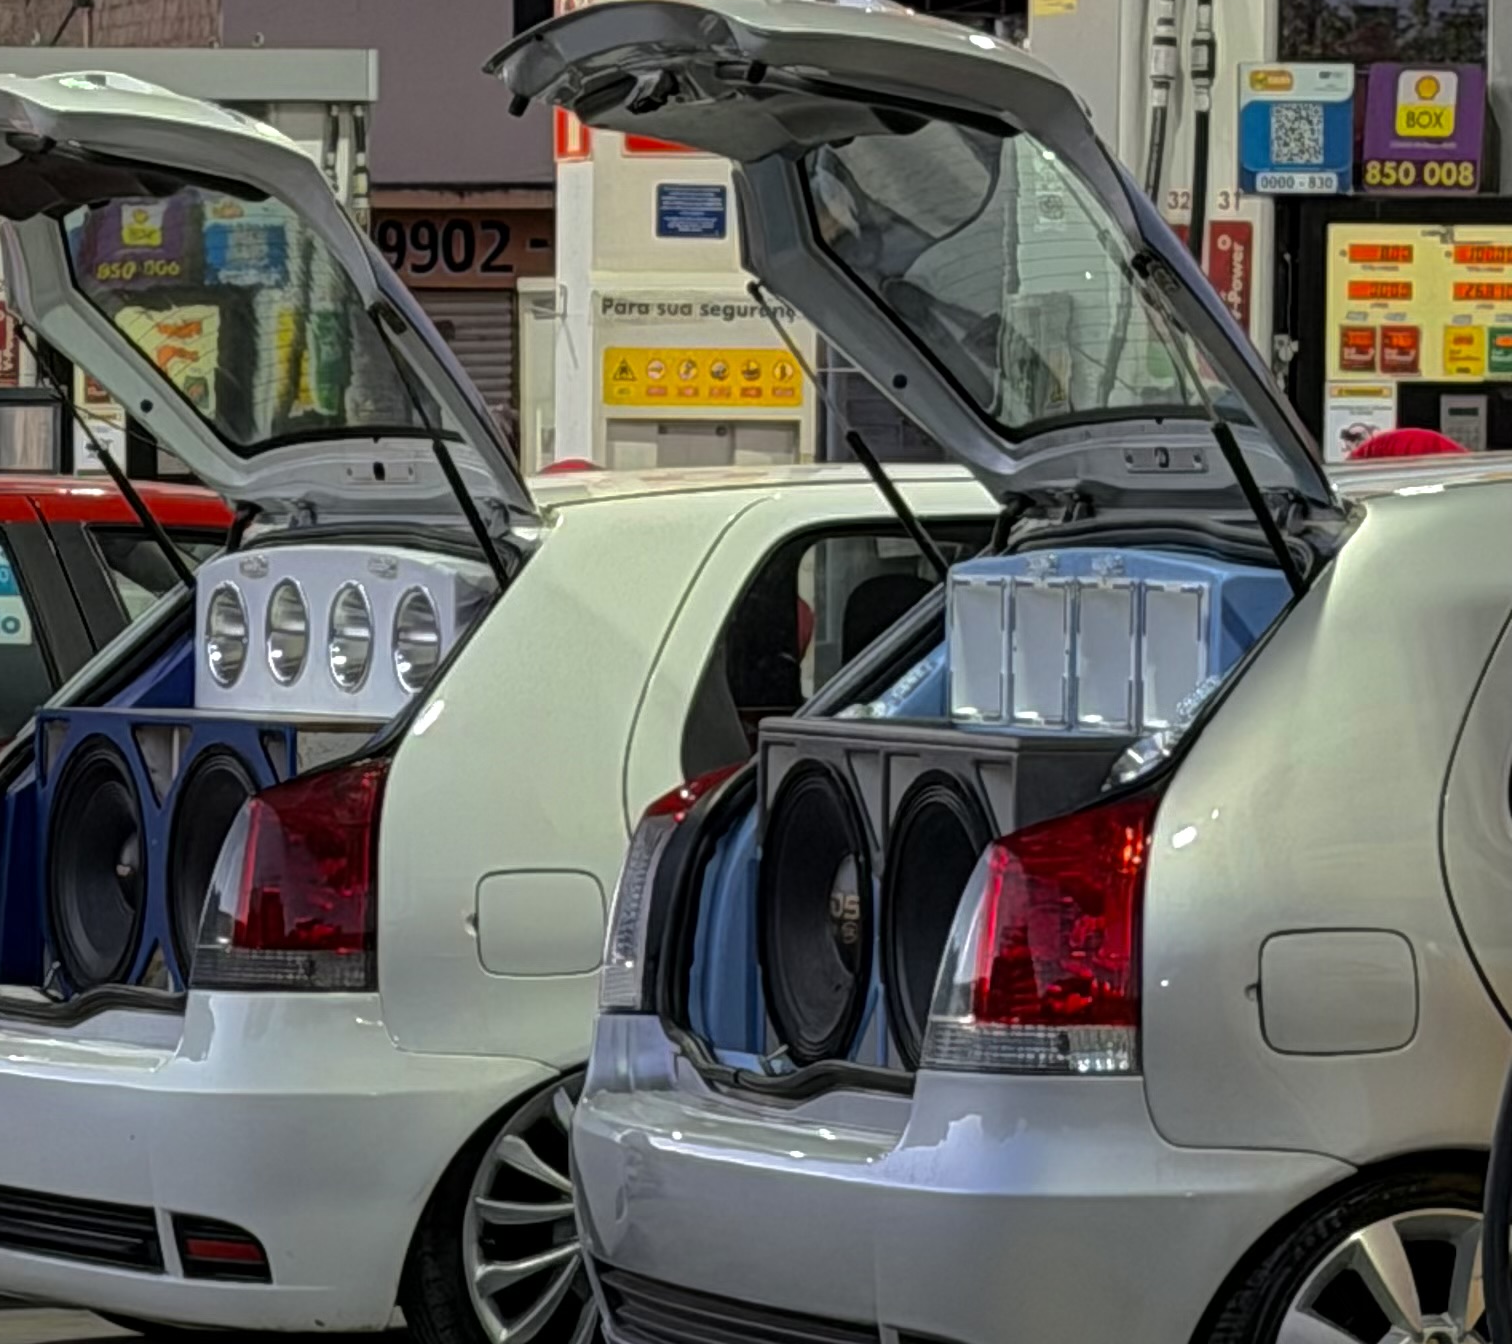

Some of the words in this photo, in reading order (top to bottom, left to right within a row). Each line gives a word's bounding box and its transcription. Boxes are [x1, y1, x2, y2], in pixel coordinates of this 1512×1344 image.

[1405, 111, 1445, 129] BOX
[1365, 159, 1417, 187] 850
[1423, 160, 1475, 187] 008
[1167, 191, 1191, 210] 32
[601, 297, 650, 316] Para
[657, 302, 693, 317] sua
